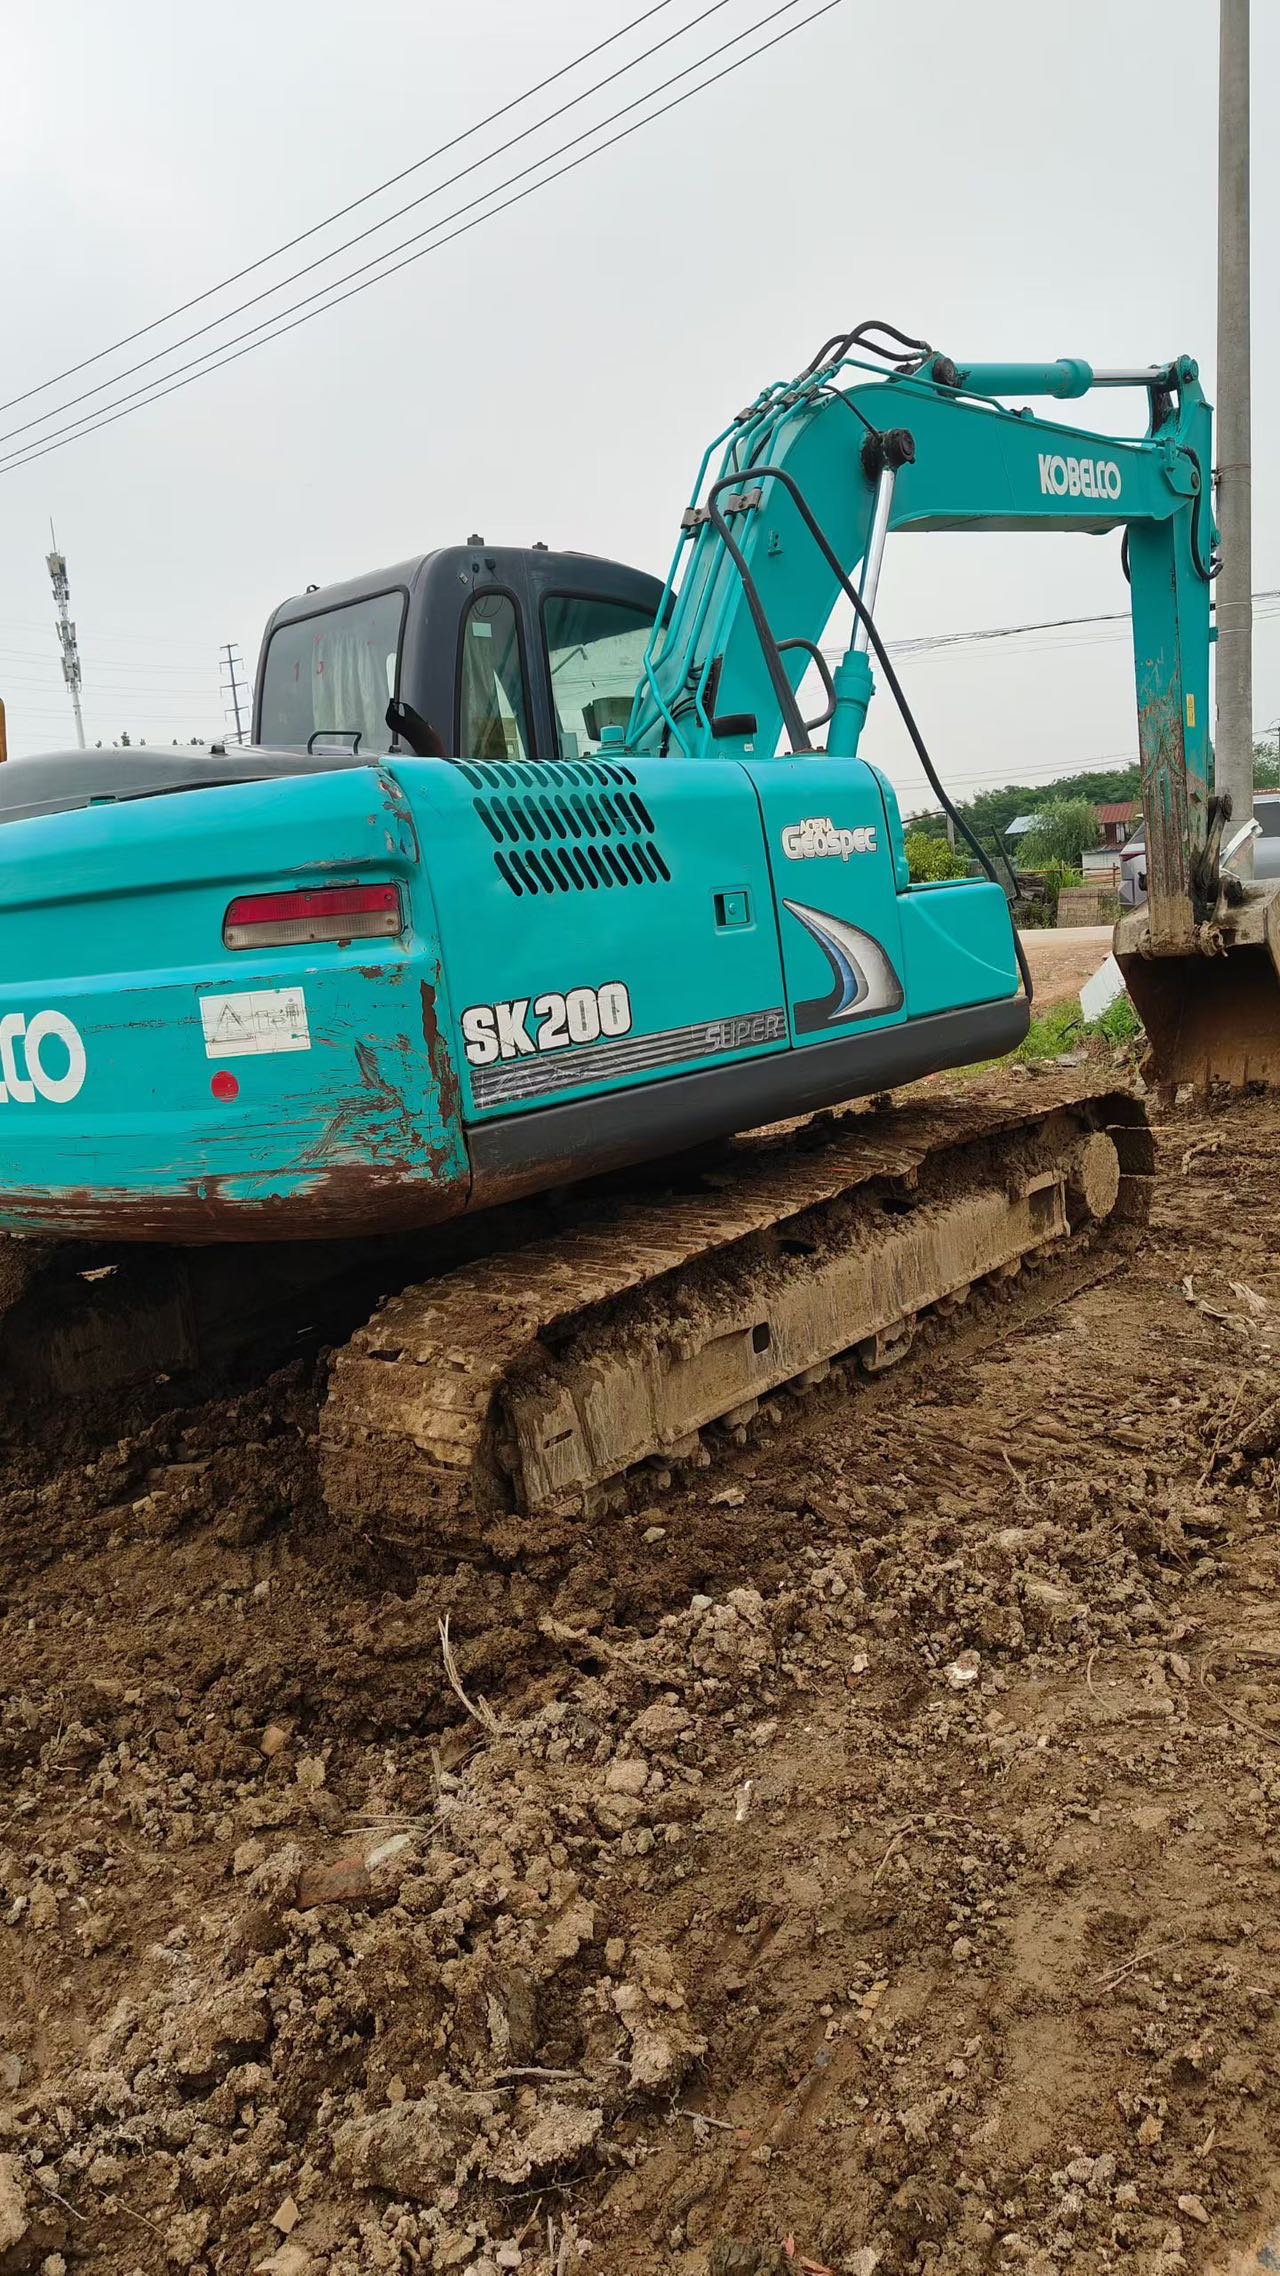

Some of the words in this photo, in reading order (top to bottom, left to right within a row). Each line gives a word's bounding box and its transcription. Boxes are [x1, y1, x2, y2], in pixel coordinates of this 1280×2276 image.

[1038, 453, 1122, 500] KOBELCO
[461, 980, 633, 1067] SK200
[704, 1014, 780, 1053] SUPER
